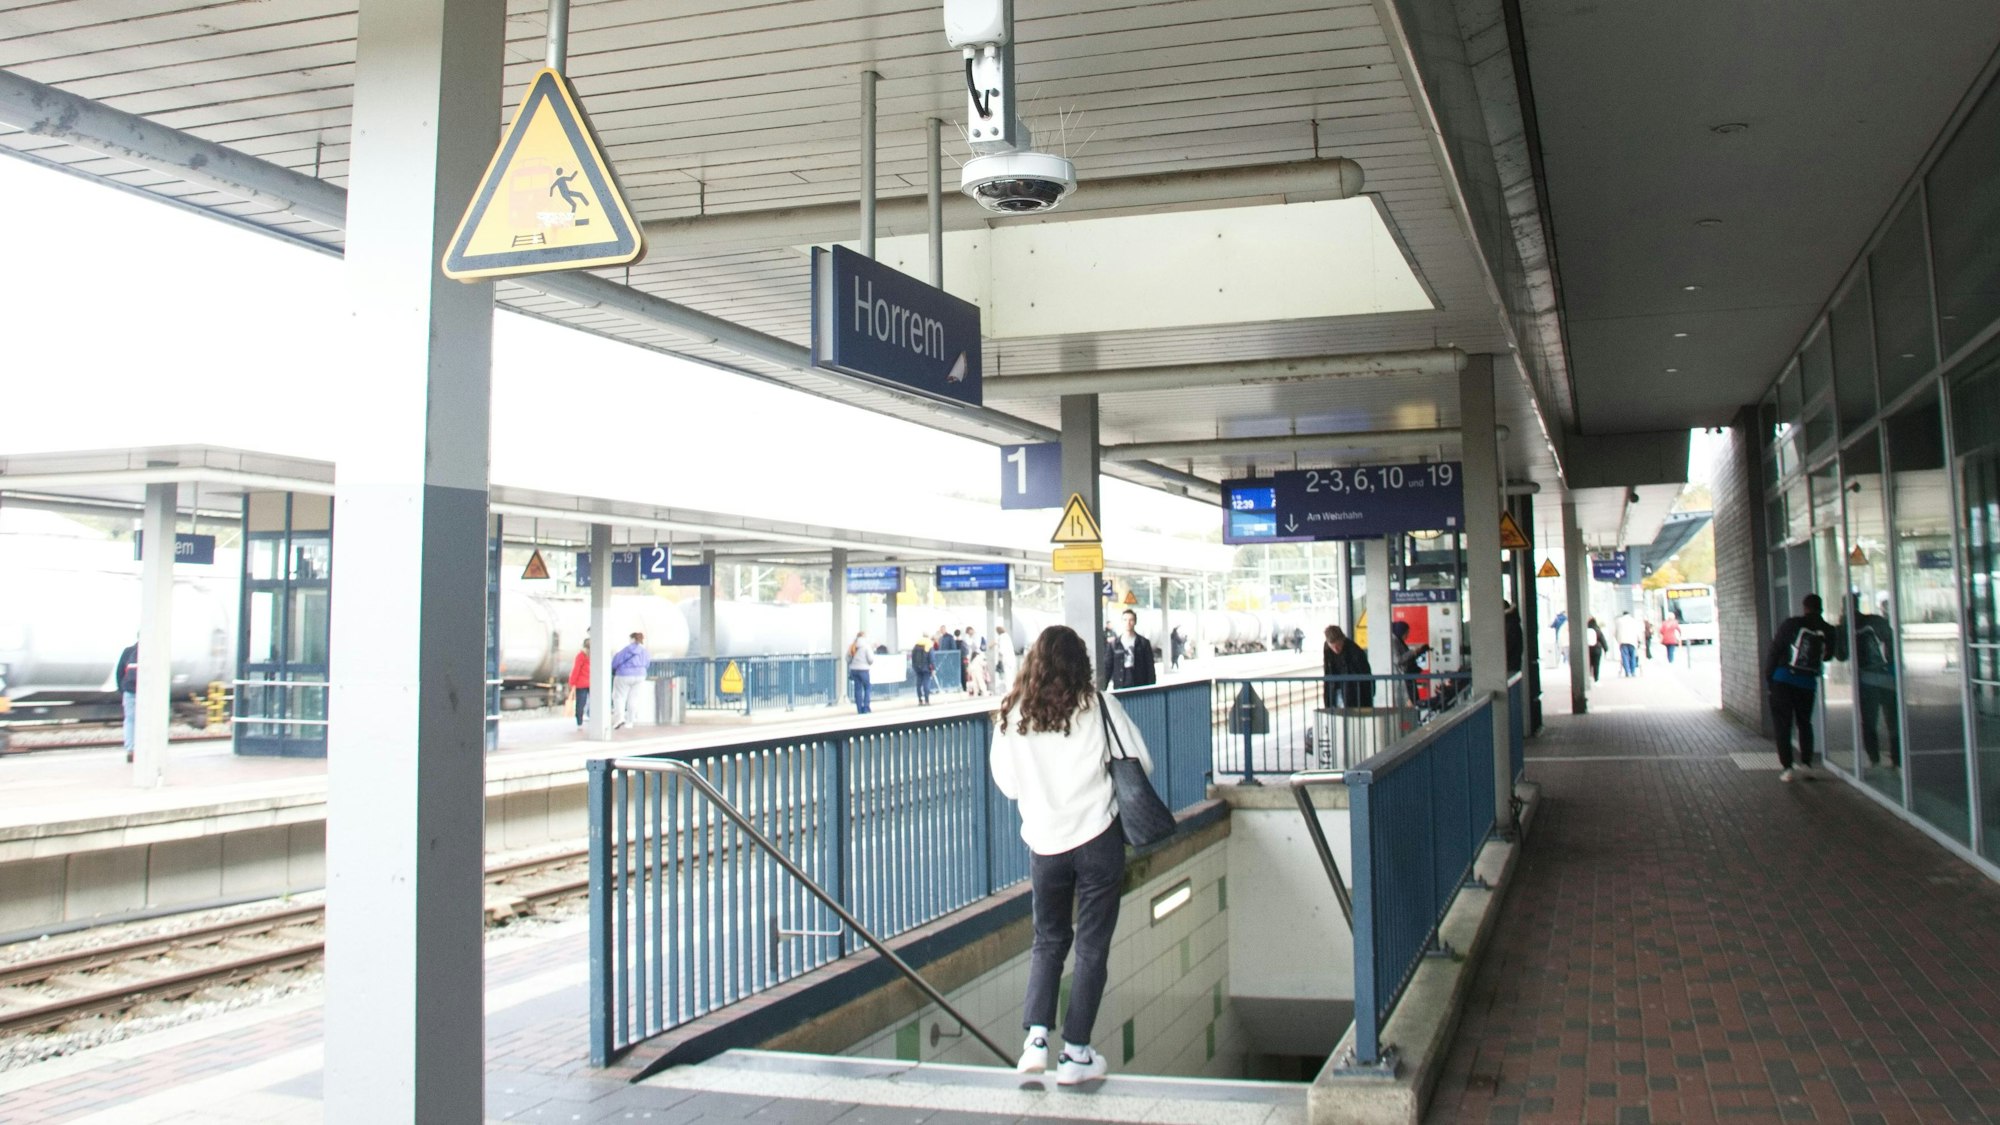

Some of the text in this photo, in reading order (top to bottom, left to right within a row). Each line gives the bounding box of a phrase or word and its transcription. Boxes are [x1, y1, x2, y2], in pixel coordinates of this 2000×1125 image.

[855, 275, 944, 361] Horrem
[1007, 446, 1026, 494] 1
[1408, 479, 1424, 488] und
[1427, 464, 1453, 487] 19
[1307, 512, 1320, 521] Am
[651, 547, 666, 573] 2
[1102, 580, 1112, 594] 2
